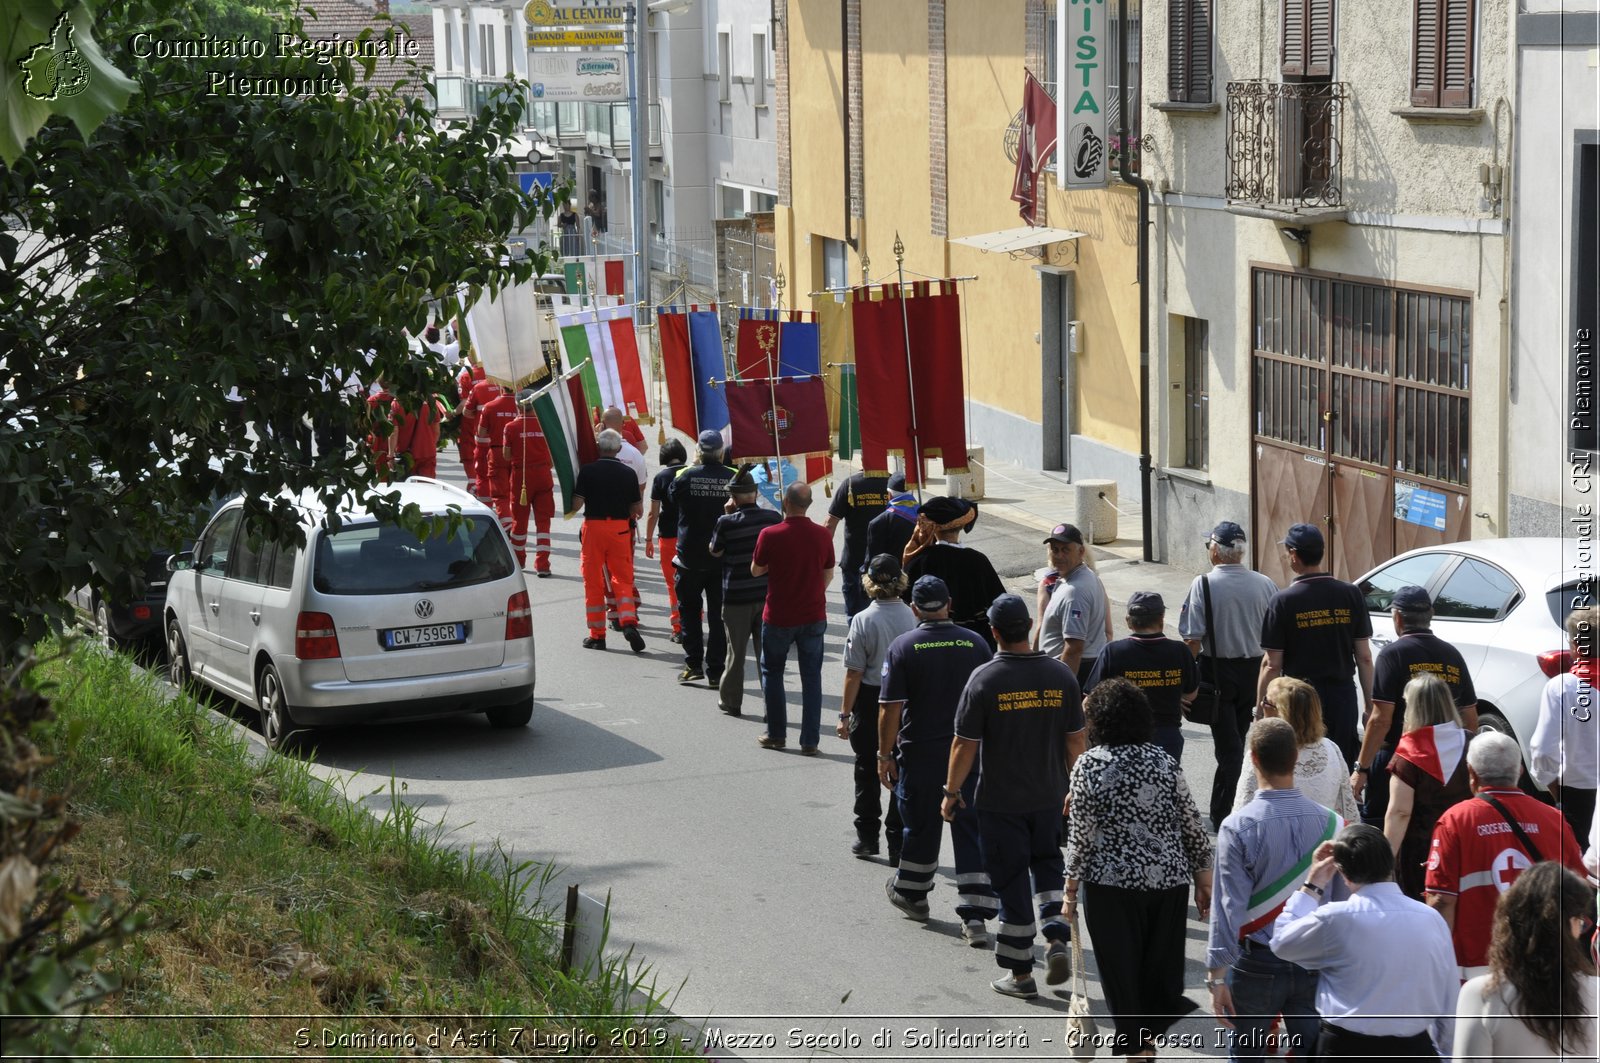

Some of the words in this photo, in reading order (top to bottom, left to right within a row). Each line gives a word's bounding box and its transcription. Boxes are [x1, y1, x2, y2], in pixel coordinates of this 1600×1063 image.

[553, 8, 569, 20] AL
[572, 7, 621, 20] CENTRO
[528, 32, 566, 41] BEVANDE
[574, 31, 623, 40] ALIMENTARI
[1071, 0, 1101, 115] ISTA
[690, 477, 718, 485] PROTEZIONE
[1296, 609, 1330, 620] PROTEZIONE
[1334, 608, 1350, 616] CIVILE
[1297, 620, 1310, 629] SAN
[394, 630, 410, 645] CW
[415, 625, 456, 642] 759GR
[913, 641, 955, 651] Protezione
[956, 639, 974, 648] Civile
[1125, 670, 1161, 679] PROTEZIONE
[1165, 669, 1182, 678] CIVILE
[1138, 679, 1164, 687] DAMIANO
[1165, 678, 1182, 686] D'ASTI
[998, 690, 1039, 702] PROTEZIONE
[1043, 689, 1063, 699] CIVILE
[998, 703, 1012, 711] SAN
[1013, 699, 1042, 710] DAMIANO
[1043, 699, 1062, 708] D'ASTI
[1477, 822, 1499, 836] CROCE
